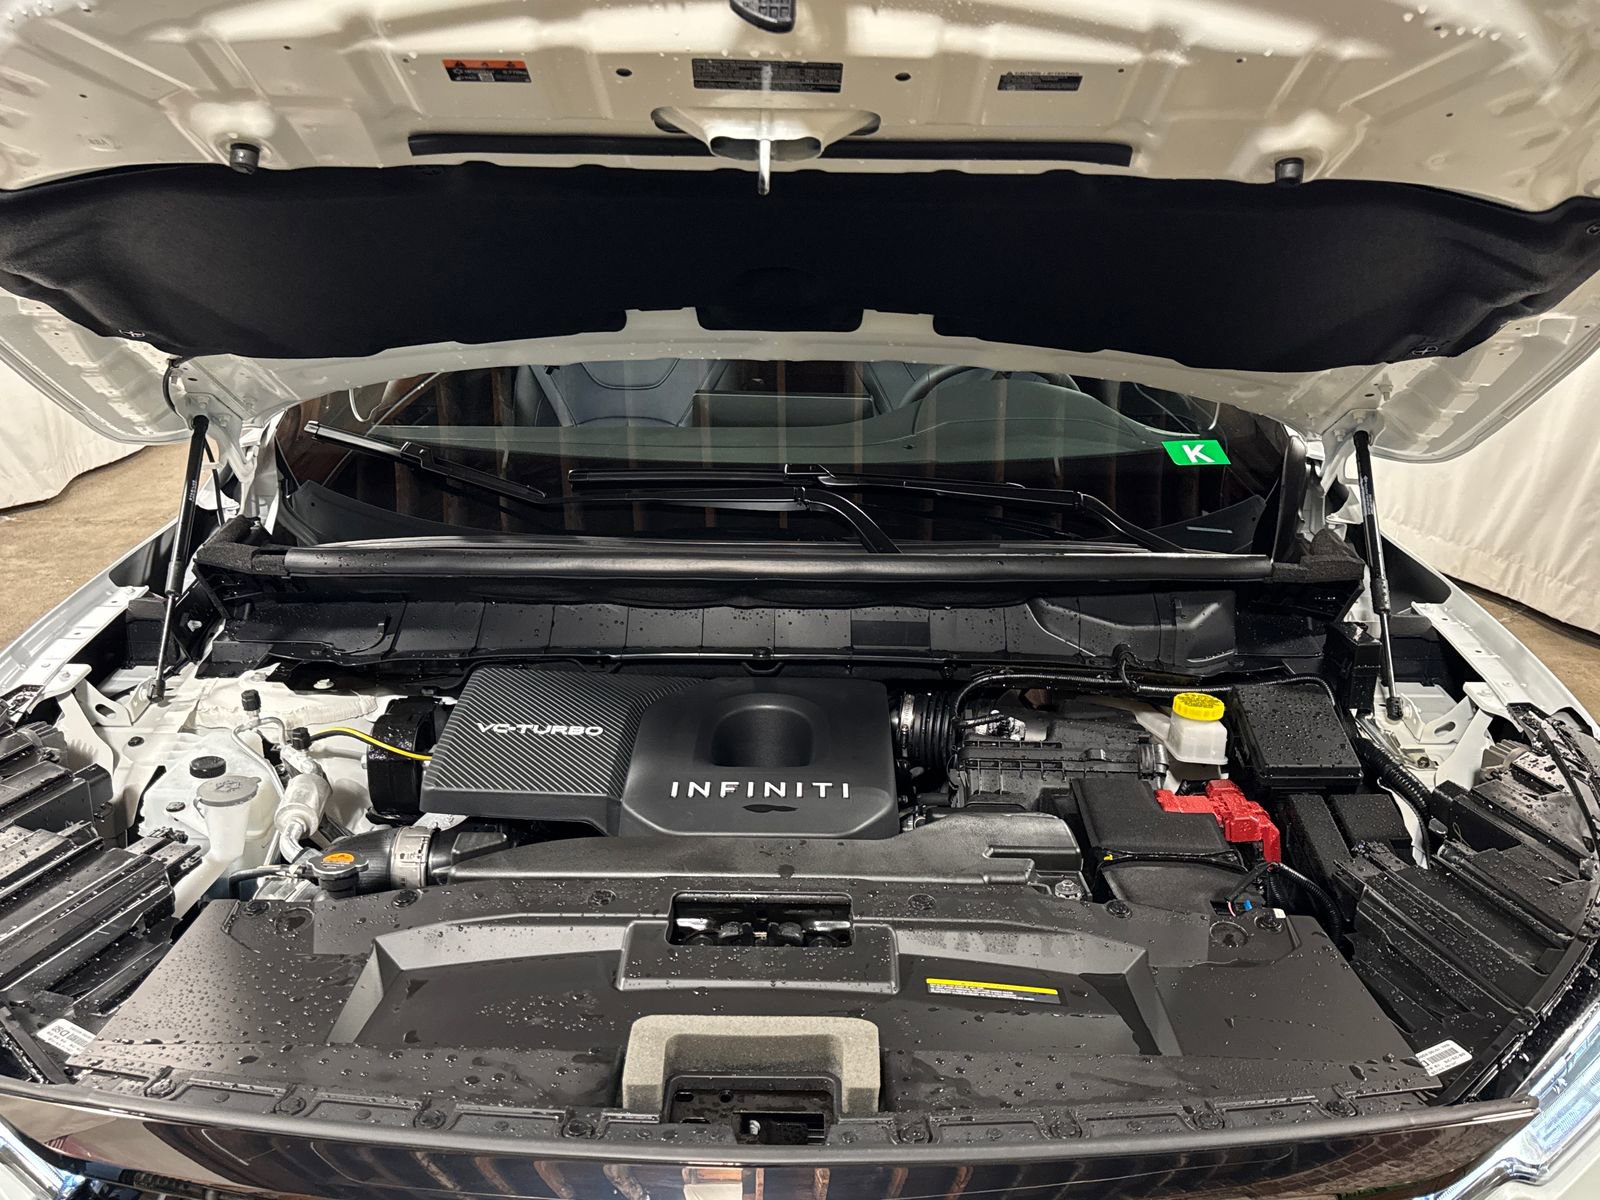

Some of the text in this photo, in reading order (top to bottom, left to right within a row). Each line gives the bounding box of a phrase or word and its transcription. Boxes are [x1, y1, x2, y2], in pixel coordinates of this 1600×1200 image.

[1181, 444, 1215, 463] K
[476, 722, 604, 736] VC-TURBO
[670, 781, 850, 799] INFINITI
